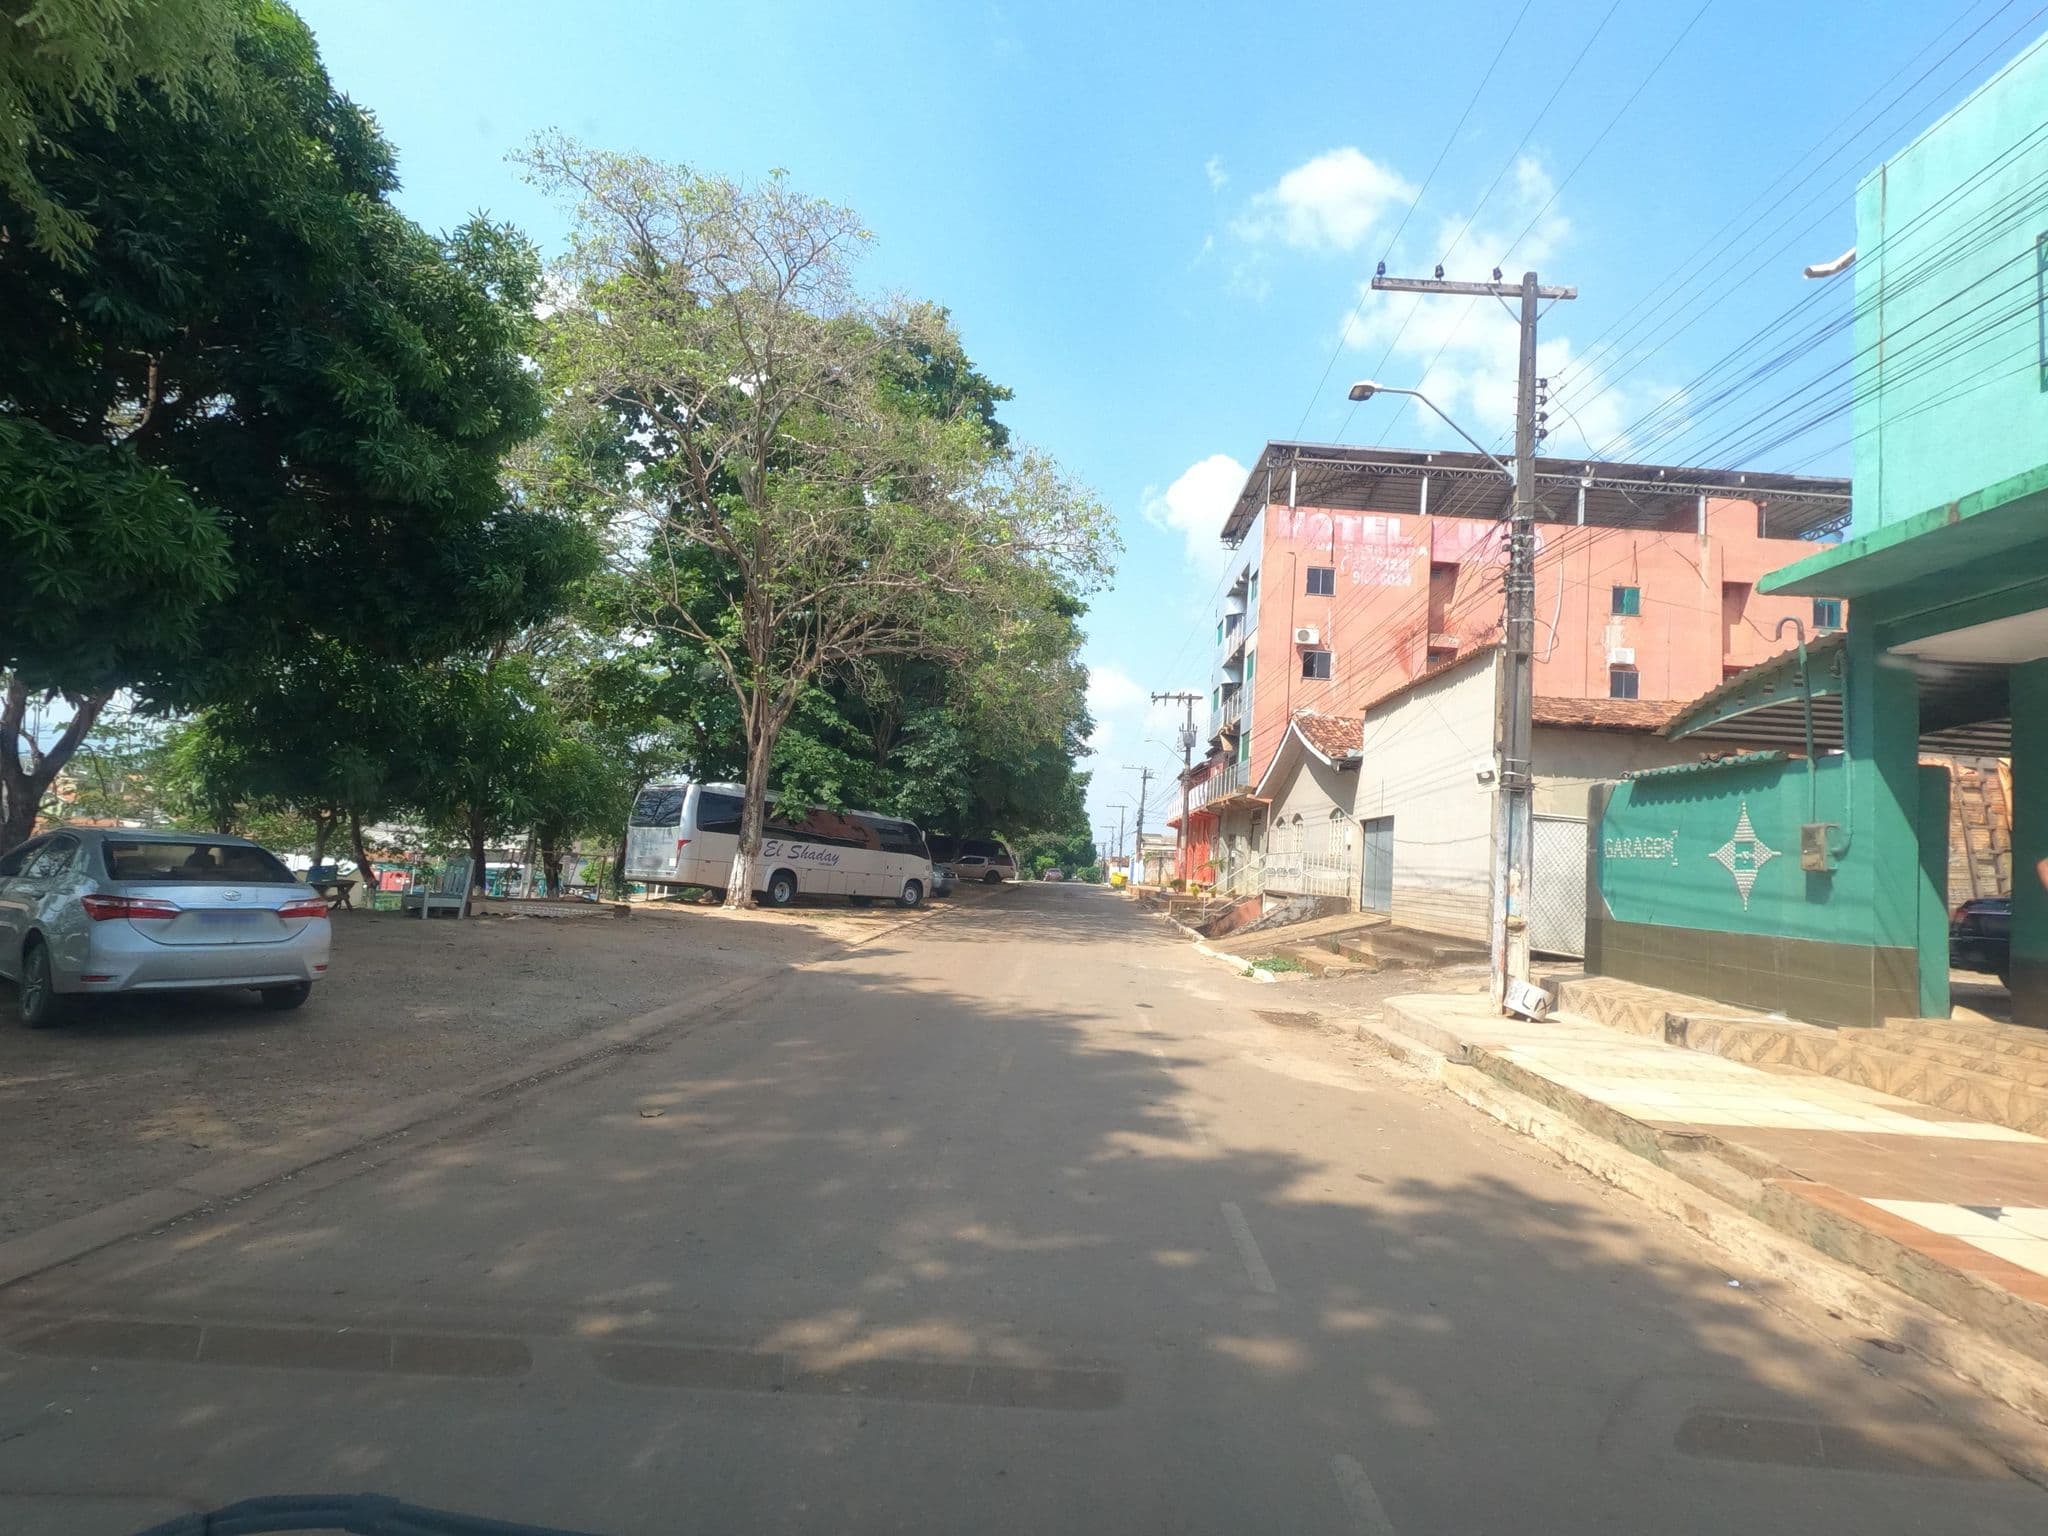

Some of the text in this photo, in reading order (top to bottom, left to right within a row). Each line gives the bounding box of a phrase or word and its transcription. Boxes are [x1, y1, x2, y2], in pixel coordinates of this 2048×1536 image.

[1278, 509, 1413, 545] HOTEL
[763, 840, 840, 866] El Shaday
[1604, 836, 1674, 858] GARAGEM
